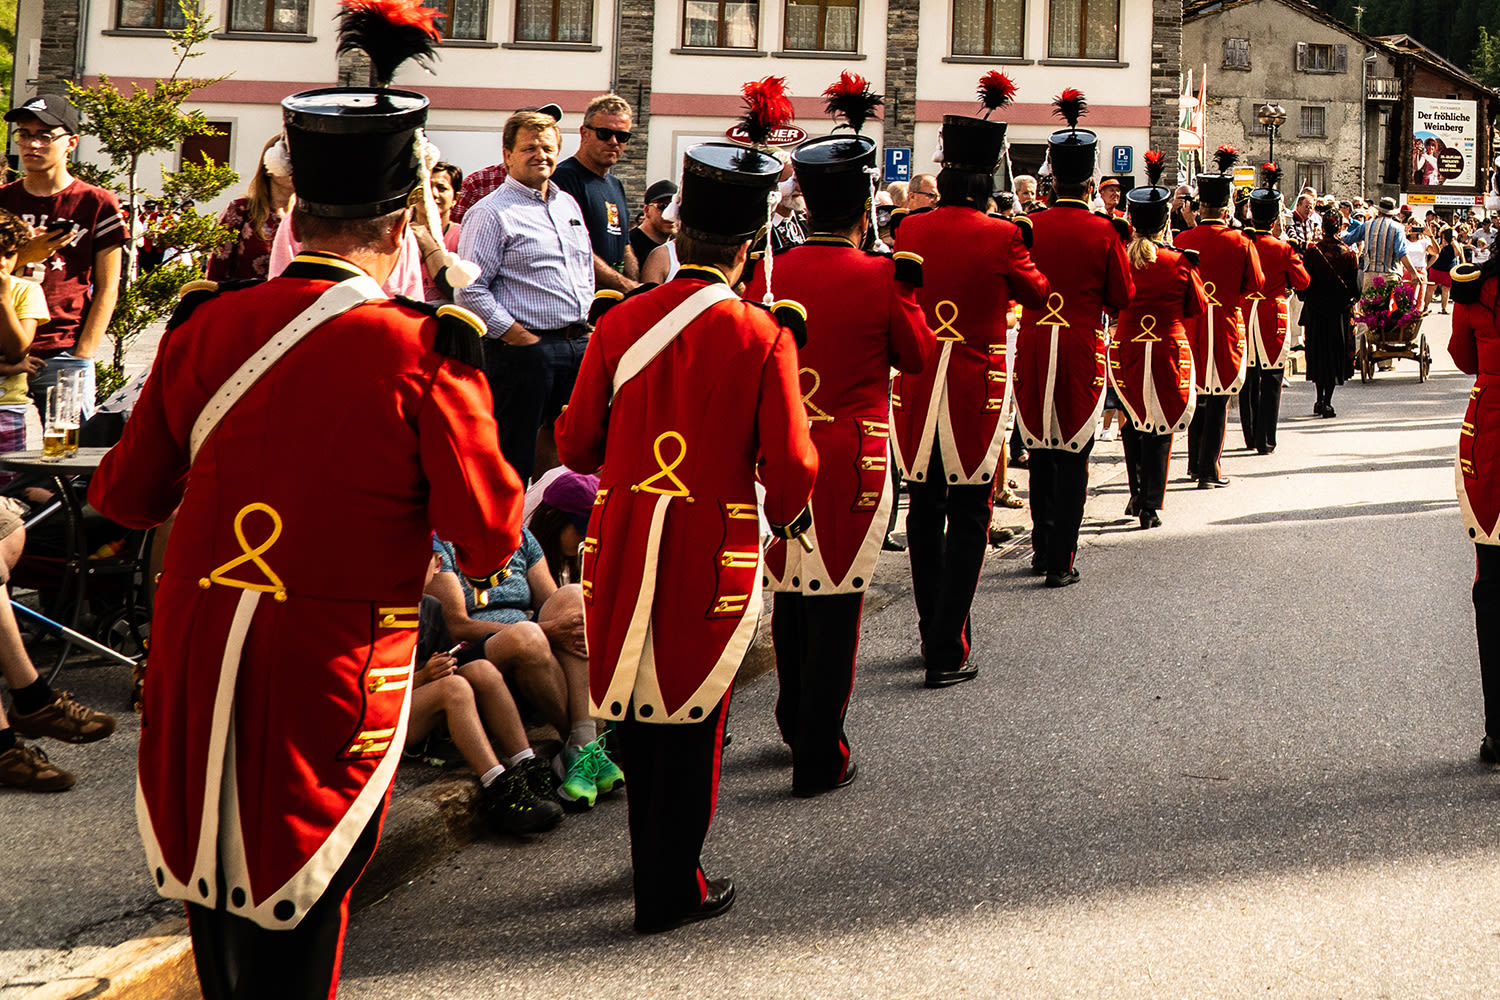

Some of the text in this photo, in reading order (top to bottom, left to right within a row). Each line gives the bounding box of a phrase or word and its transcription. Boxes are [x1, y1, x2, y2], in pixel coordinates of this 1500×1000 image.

[1417, 111, 1470, 122] Der fröhliche
[1424, 122, 1464, 133] Weinberg
[893, 151, 903, 165] P
[1118, 148, 1125, 159] P
